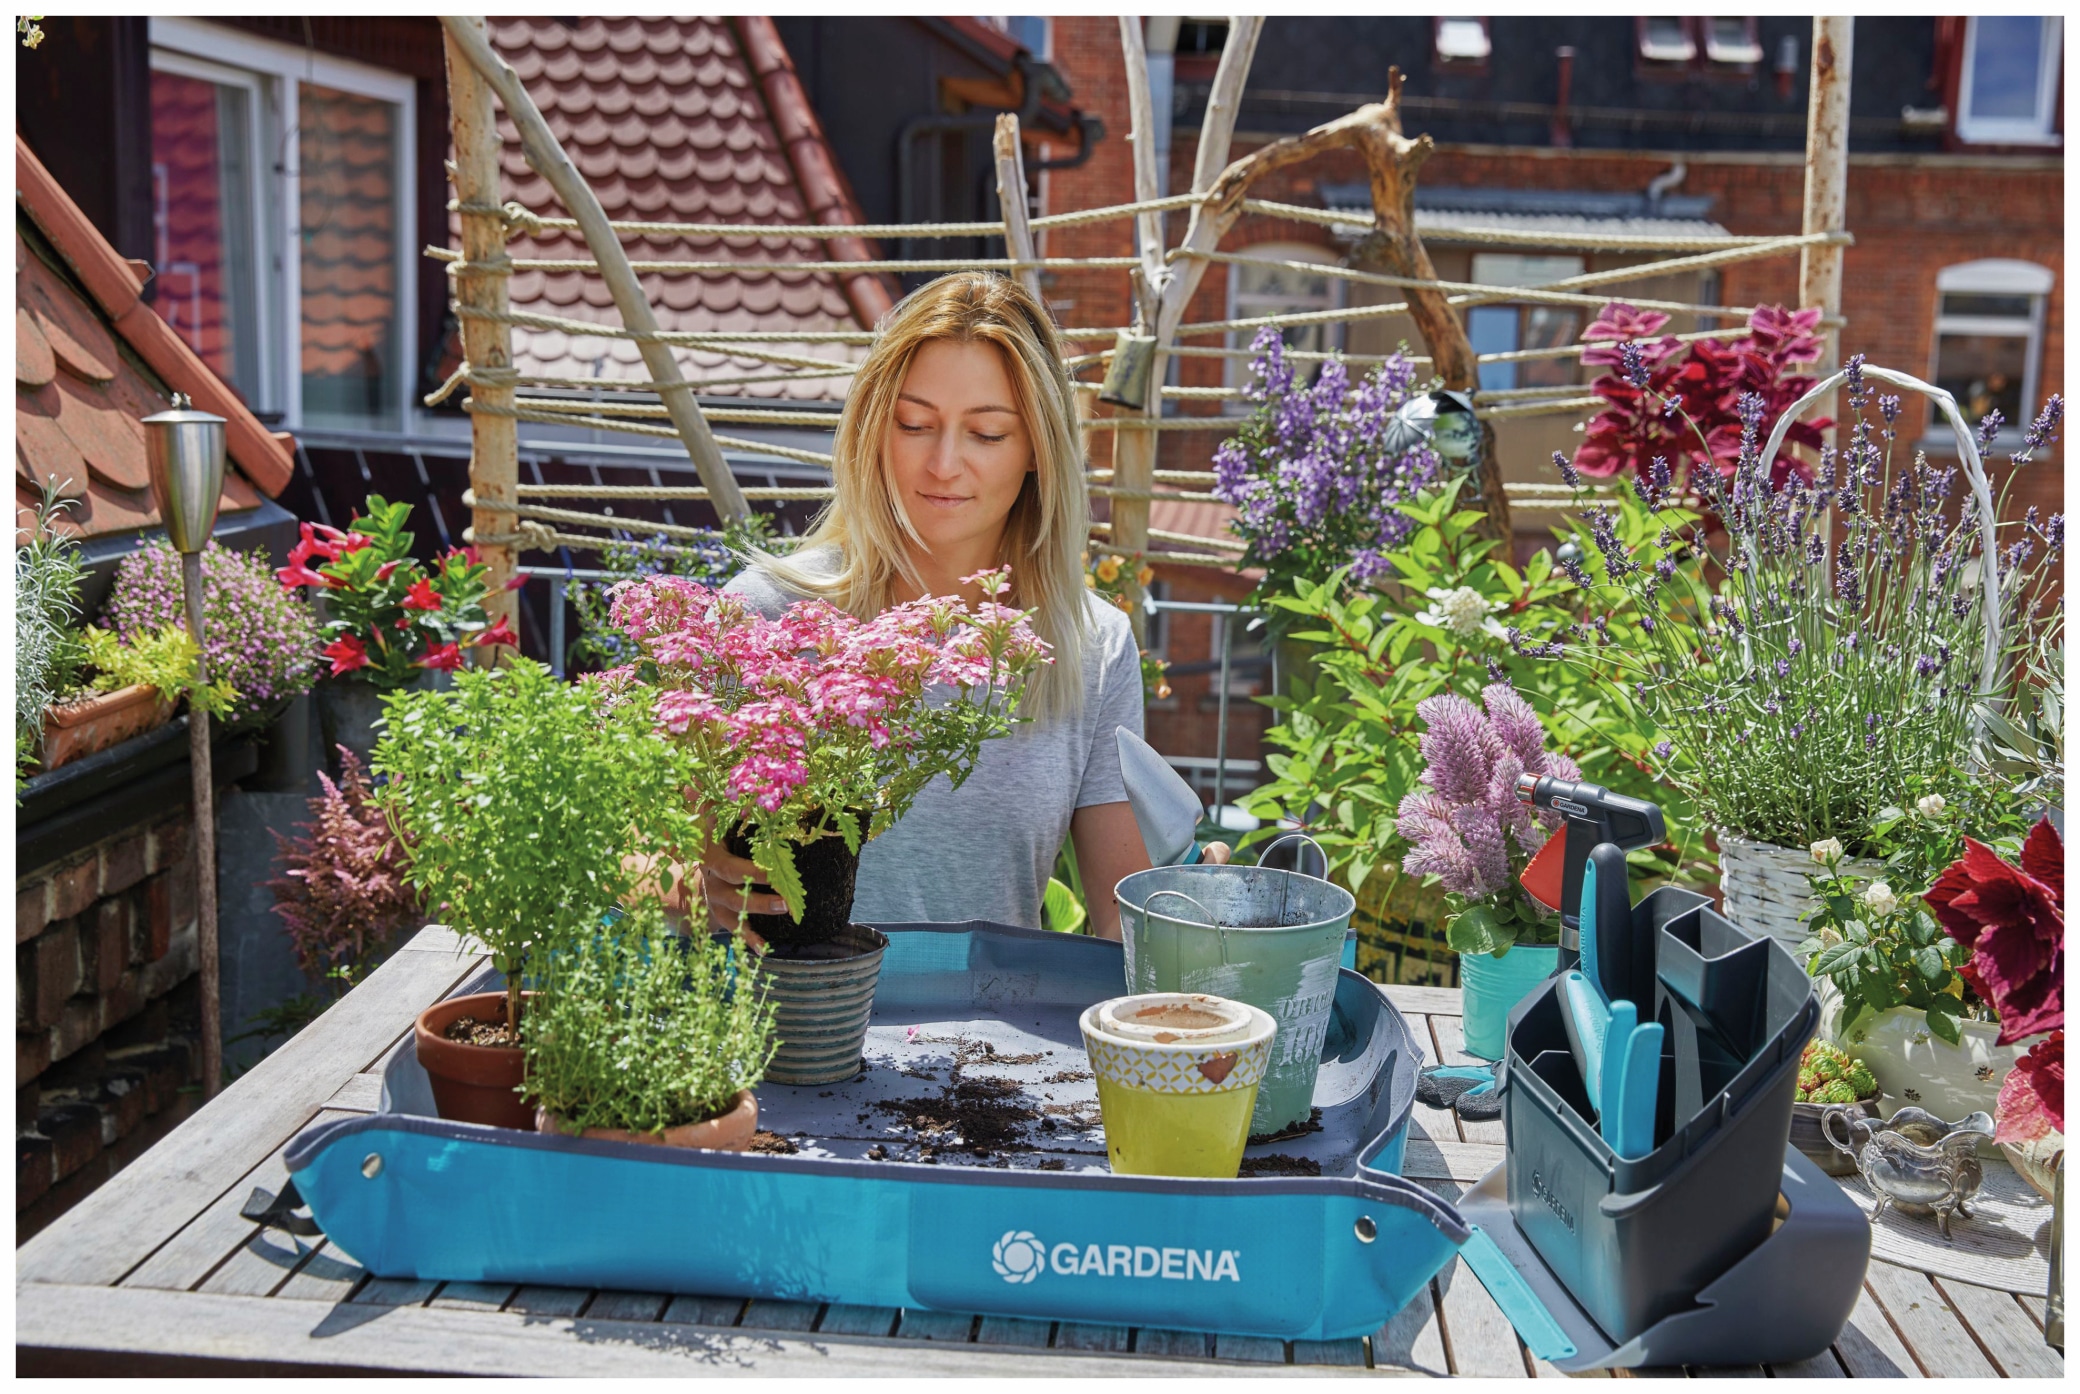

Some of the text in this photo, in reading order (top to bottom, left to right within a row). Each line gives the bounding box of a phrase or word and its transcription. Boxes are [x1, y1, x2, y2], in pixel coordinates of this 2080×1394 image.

[1559, 802, 1585, 813] GARDENA
[1541, 1185, 1575, 1236] GARDENA
[1050, 1242, 1240, 1282] GARDENA
